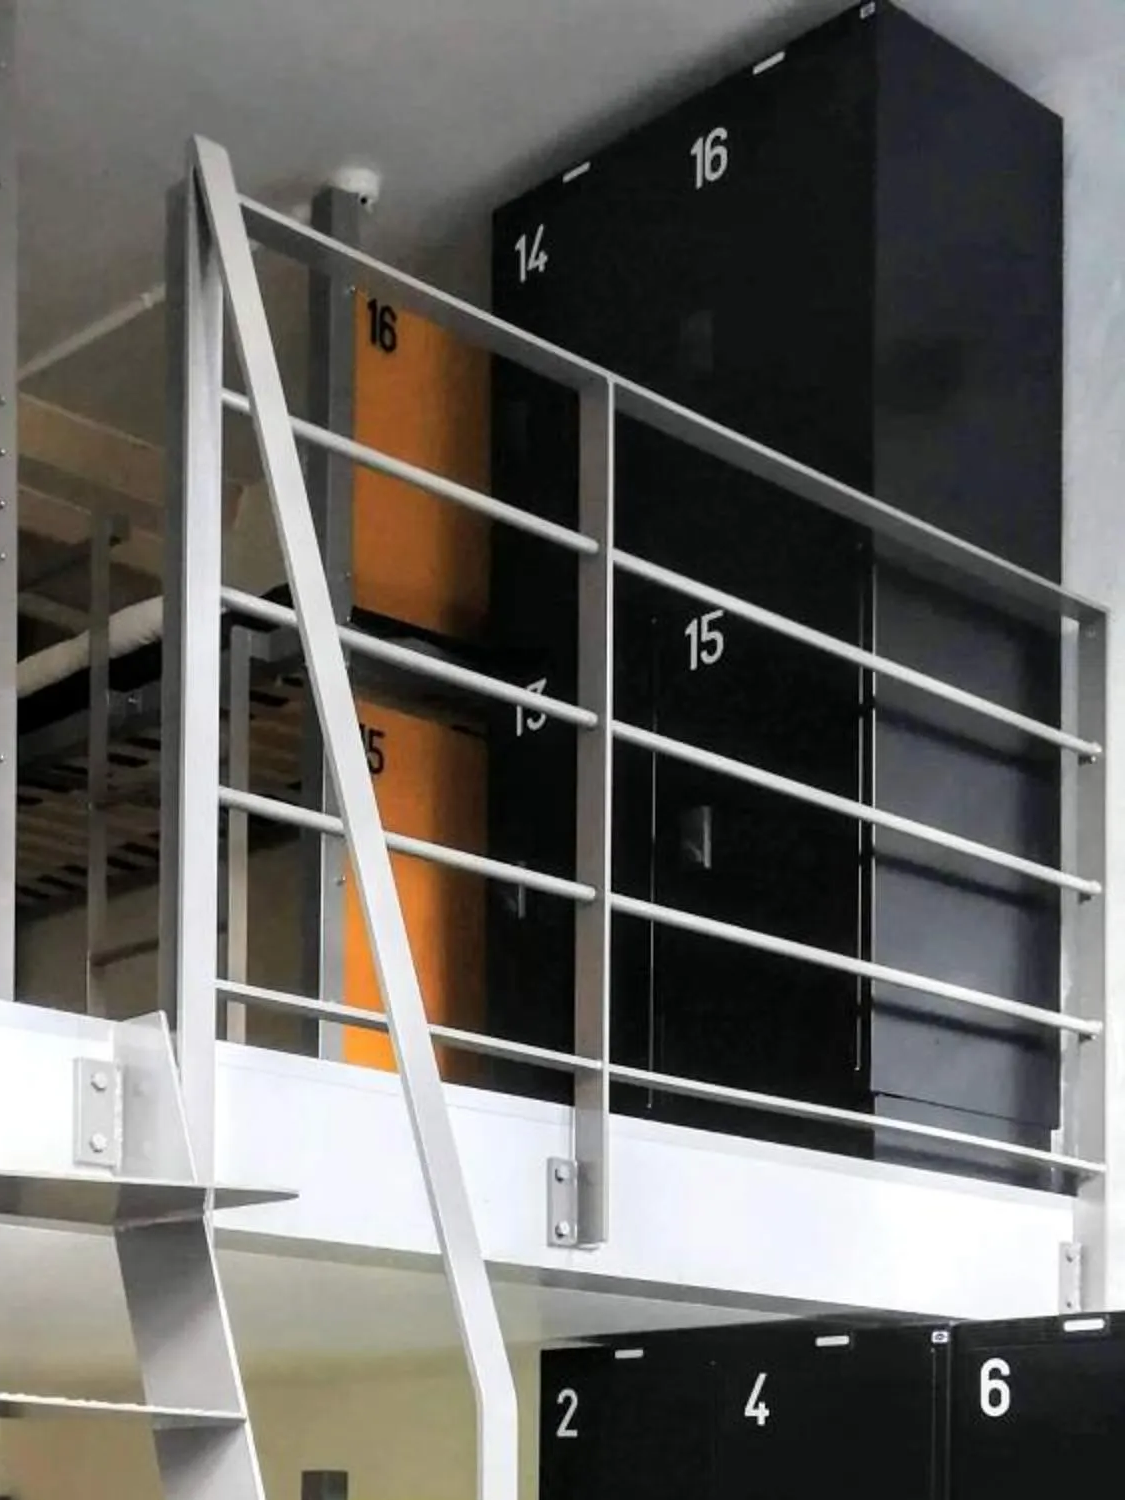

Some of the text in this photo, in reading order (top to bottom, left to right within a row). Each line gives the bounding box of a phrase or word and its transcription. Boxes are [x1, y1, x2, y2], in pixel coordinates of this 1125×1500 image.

[690, 126, 728, 189] 16
[514, 223, 548, 283] 14
[366, 297, 398, 354] 16
[684, 609, 724, 671] 15
[555, 1388, 579, 1439] 2
[743, 1372, 771, 1427] 4
[979, 1356, 1011, 1418] 6
